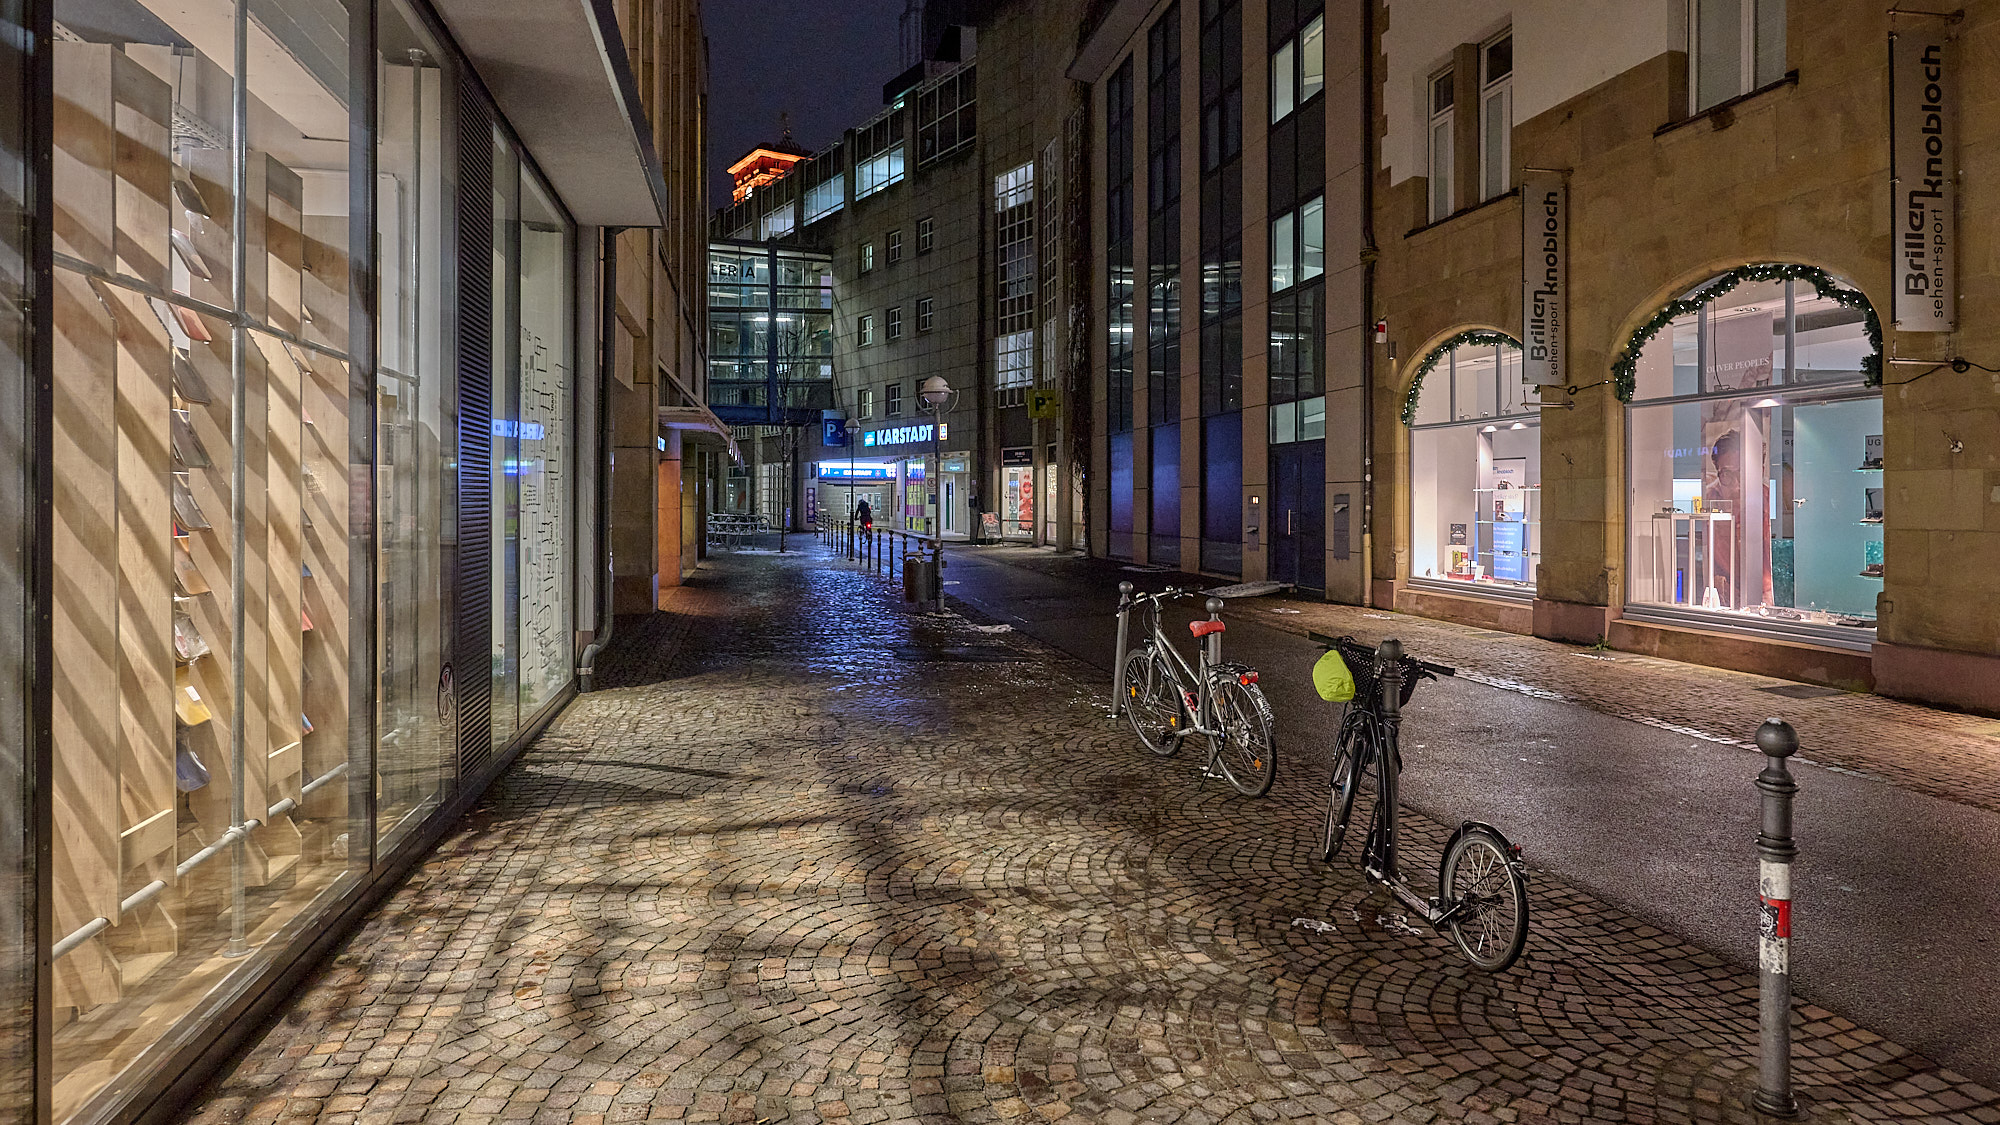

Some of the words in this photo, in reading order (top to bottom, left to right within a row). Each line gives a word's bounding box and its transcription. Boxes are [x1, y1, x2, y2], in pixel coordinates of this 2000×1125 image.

[1920, 45, 1943, 199] knobloch
[1543, 191, 1558, 296] knobloch
[1905, 190, 1929, 296] Brillen
[1929, 208, 1946, 318] sehen+sport
[1530, 289, 1548, 361] Brillen
[1547, 301, 1560, 376] sehen+sport
[1706, 362, 1734, 373] OLIVER
[1735, 357, 1770, 370] PEOPLES
[827, 423, 836, 437] P
[876, 424, 934, 446] KARSTADT
